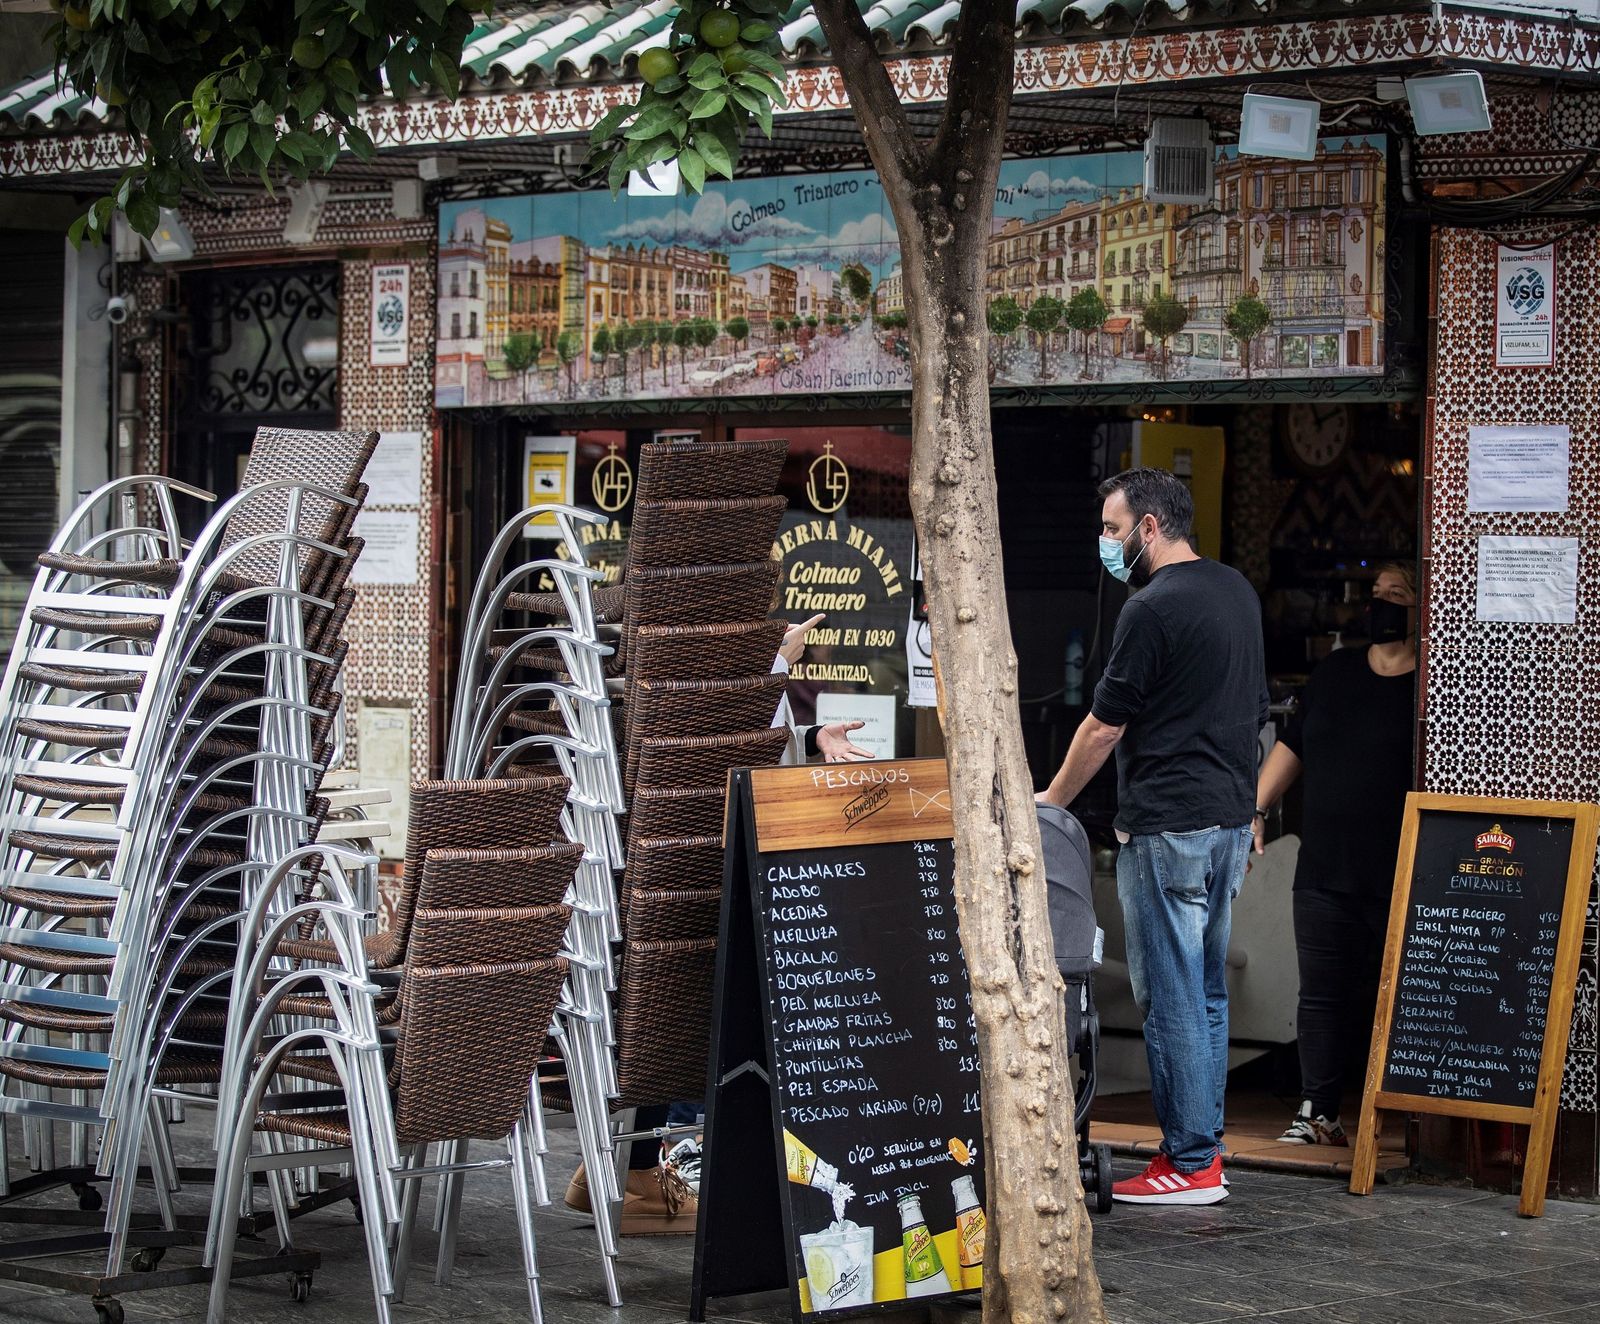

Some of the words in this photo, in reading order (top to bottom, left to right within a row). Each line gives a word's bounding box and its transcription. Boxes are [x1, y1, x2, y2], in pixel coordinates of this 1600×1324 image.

[732, 198, 786, 232] Colmao
[794, 179, 859, 206] Trianero
[380, 280, 403, 293] 24h
[1506, 285, 1545, 300] VSG
[377, 310, 403, 323] VSG
[828, 368, 883, 390] Jacinto
[846, 525, 902, 597] MIAMI
[789, 561, 860, 585] Colmao
[785, 586, 866, 611] Trianero
[844, 629, 861, 646] EN
[864, 629, 896, 647] 1930
[806, 664, 874, 685] CLIMATIZAD
[810, 768, 909, 789] PESCADOS
[844, 785, 889, 825] Schweppes
[1477, 834, 1512, 847] SAIMAZA
[1459, 863, 1523, 877] SELECCIÓN
[1480, 857, 1504, 865] GRAN
[767, 861, 866, 882] CALAMARES
[772, 884, 820, 901] ADOBO
[1451, 876, 1522, 893] ENTRANTES
[1415, 904, 1460, 918] TOMATE
[773, 925, 838, 945] MERLUZA
[1415, 921, 1447, 933] ENSL.
[774, 949, 838, 969] BACALAO
[776, 967, 876, 990] BOQUERONES
[1402, 975, 1441, 990] GAMBAS
[813, 991, 881, 1011] MERLUZA
[1401, 991, 1457, 1005] CROQUETAS
[783, 1016, 840, 1033] GAMBAS
[1396, 1020, 1468, 1035] CHANQUETADA
[848, 1028, 913, 1048] PLANCHA
[1389, 1063, 1427, 1077] PATATAS
[1463, 1074, 1492, 1088] SALSA
[788, 1081, 813, 1096] PEZ
[822, 1077, 879, 1093] ESPADA
[1427, 1084, 1450, 1095] IVA
[1455, 1085, 1483, 1097] INCL.
[790, 1105, 849, 1123] PESCADO
[913, 1093, 942, 1116] (P/P)
[962, 1090, 981, 1113] 11'
[929, 1138, 942, 1148] EN
[848, 1145, 874, 1164] 0'60
[872, 1161, 896, 1175] MESA
[899, 1159, 913, 1169] POR
[864, 1190, 889, 1205] IVA
[893, 1181, 930, 1197] INCL.
[828, 1271, 860, 1302] Schweppes
